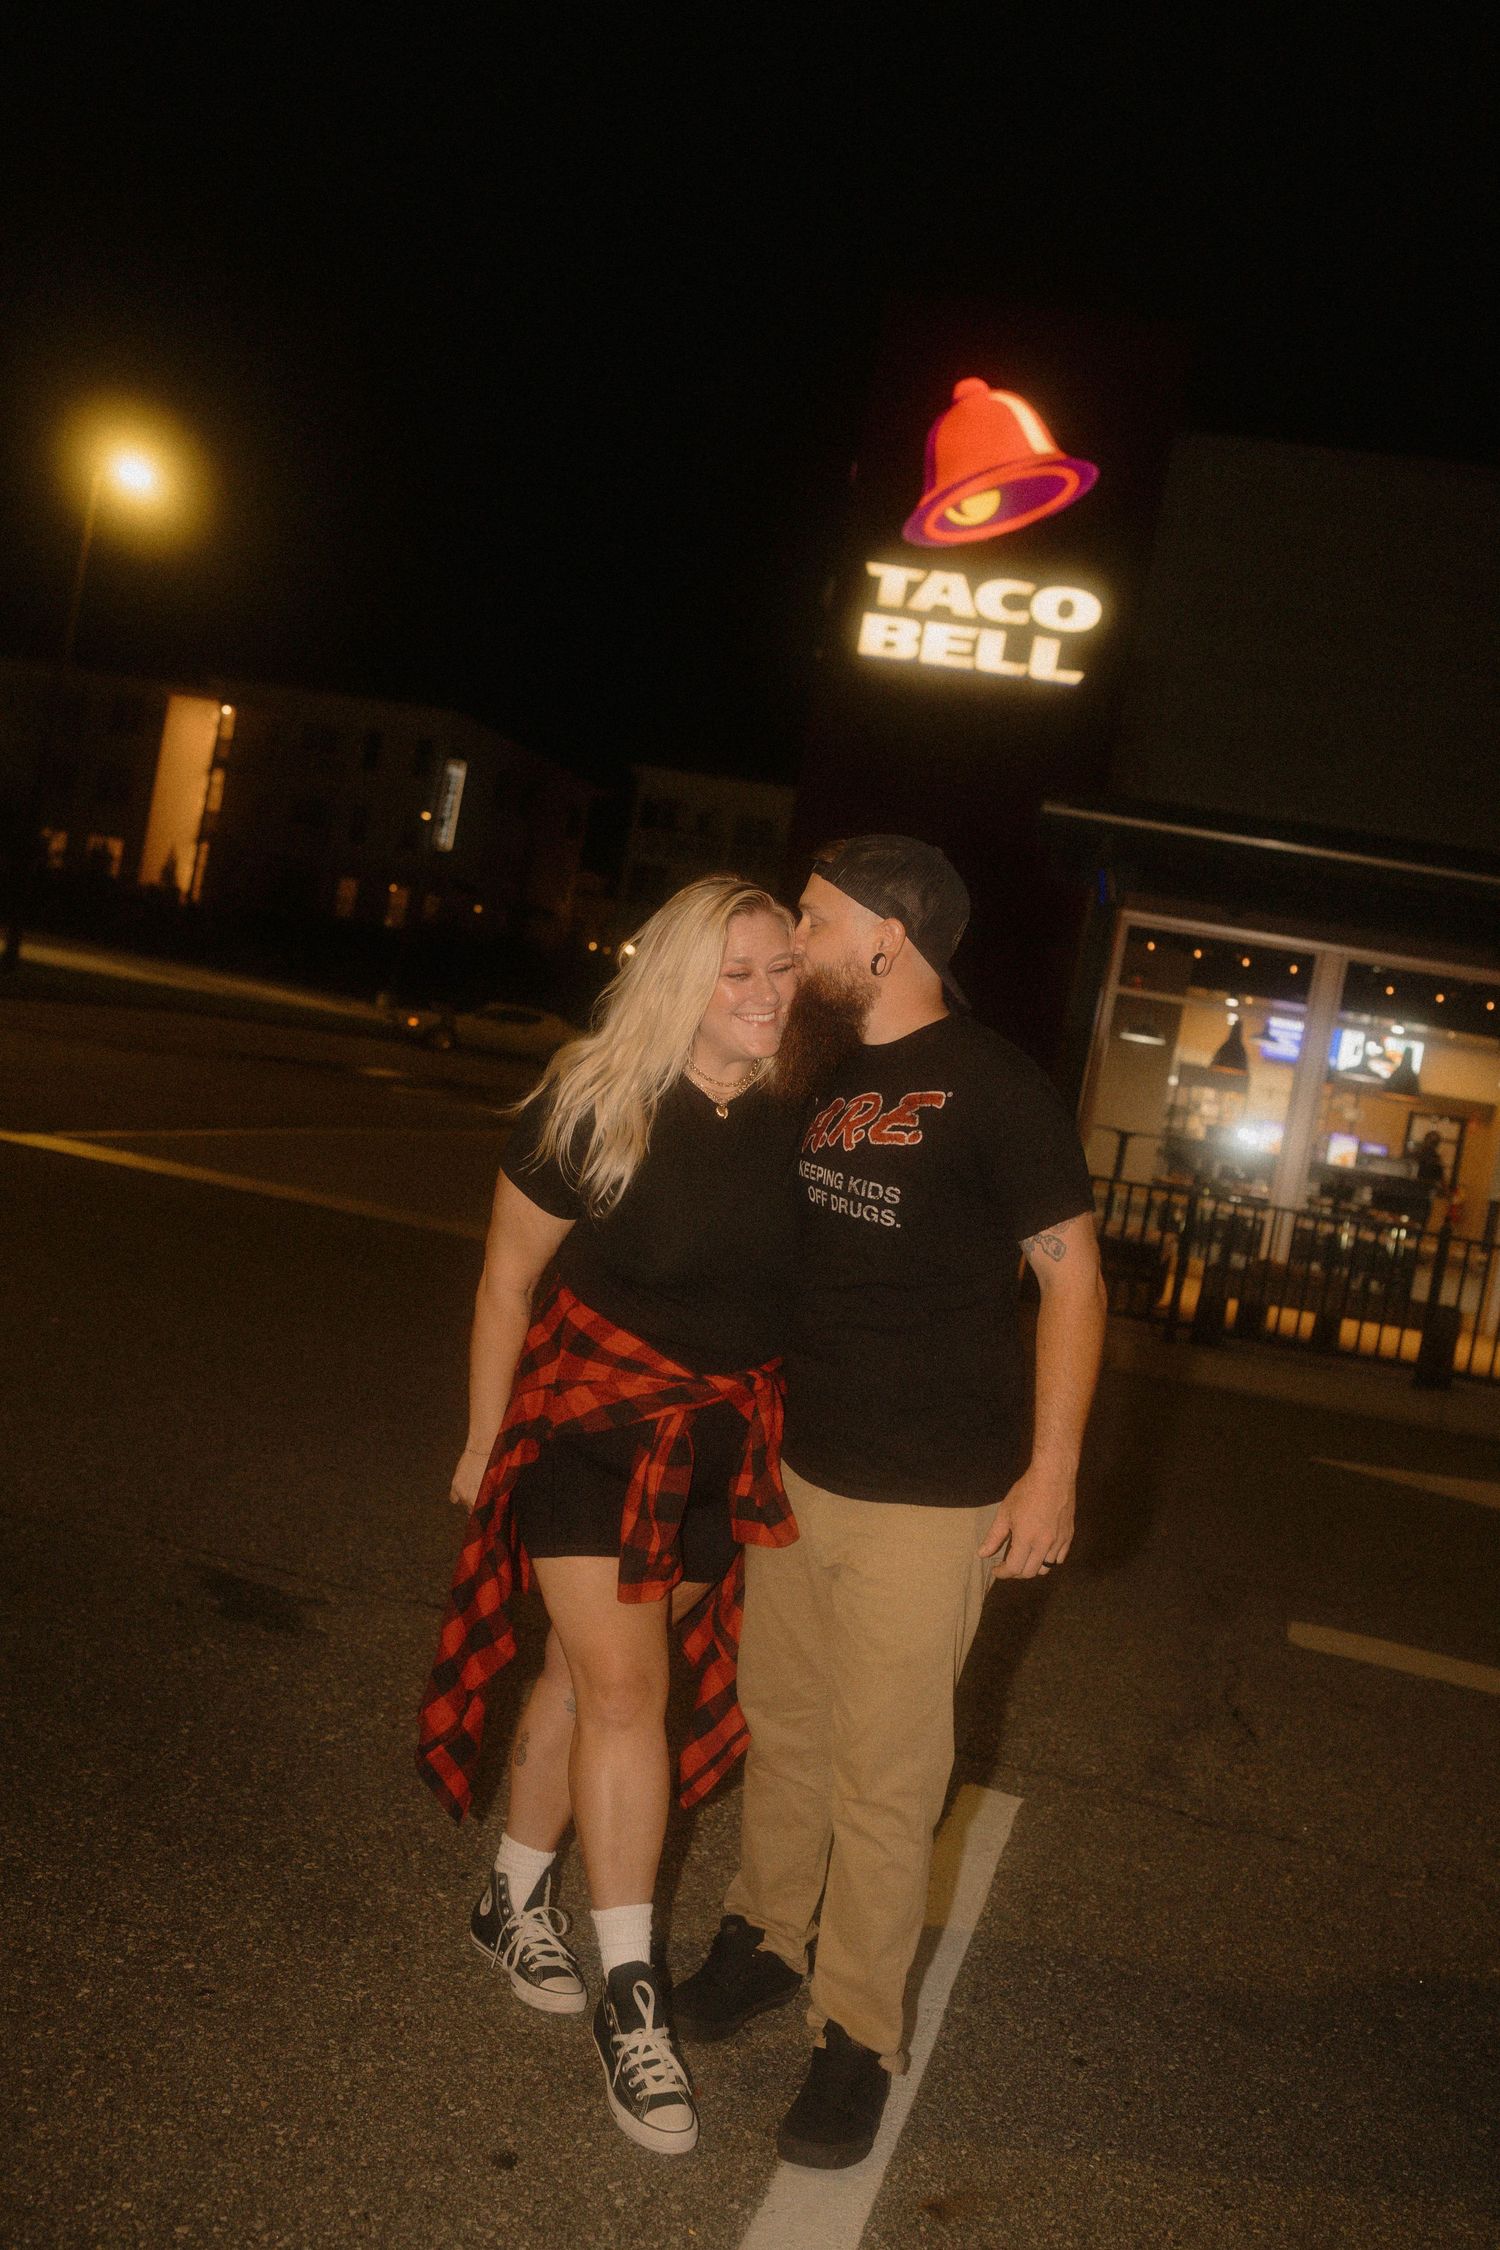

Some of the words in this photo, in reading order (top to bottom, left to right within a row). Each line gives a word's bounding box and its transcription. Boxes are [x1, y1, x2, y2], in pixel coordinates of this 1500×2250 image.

[866, 561, 1102, 633] TACO
[857, 612, 1085, 686] BELL
[799, 1159, 844, 1190] KEEPING
[848, 1175, 901, 1205] KIDS
[808, 1185, 828, 1207] OFF
[830, 1193, 901, 1229] DRUGS.
